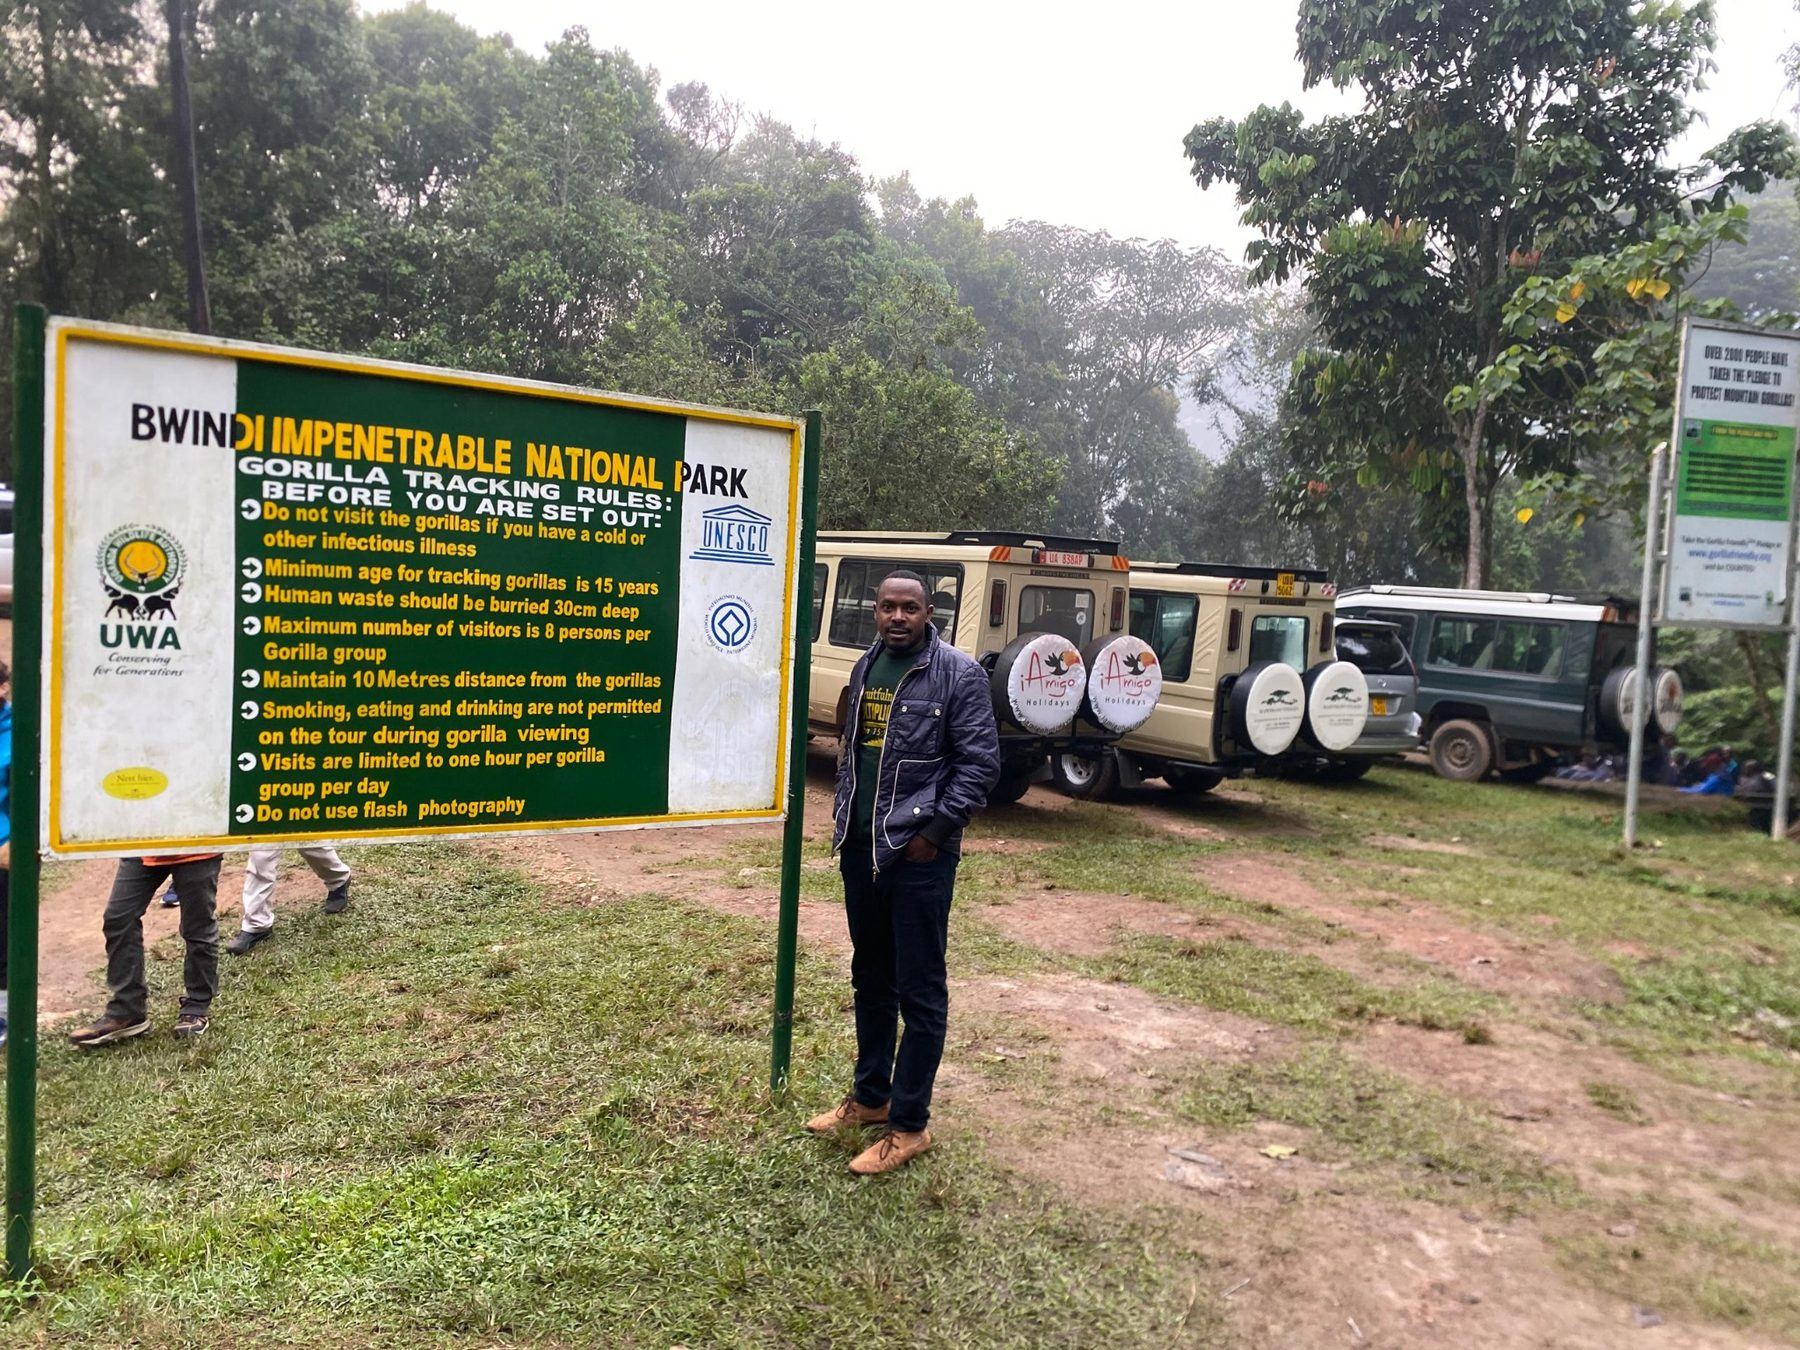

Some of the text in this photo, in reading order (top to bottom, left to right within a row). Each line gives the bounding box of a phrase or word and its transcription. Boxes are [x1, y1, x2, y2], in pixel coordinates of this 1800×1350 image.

[1705, 345, 1722, 360] OVER
[1745, 349, 1769, 364] PEOPLE
[1771, 351, 1788, 367] HAVE
[1709, 366, 1782, 386] TAKEN THE PLEDGE TO
[1691, 385, 1722, 401] PROTECT
[1724, 388, 1759, 404] MOUNTAIN
[131, 403, 749, 499] BWINDI IMPENETRABLE NATIONAL PARK
[238, 456, 672, 511] GORILLA TRACKING RULES:
[262, 481, 662, 528] BEFORE YOU ARE SET OUT:
[263, 501, 646, 546] Do not visit the gorillas if you have a cold or
[263, 530, 477, 557] other infectious illness
[703, 520, 768, 552] UNESCO
[265, 558, 659, 598] Minimum age for tracking gorillas is 15 years
[265, 584, 639, 622] Human waste should be burried 30cm deep
[100, 624, 182, 650] UWA
[264, 616, 651, 644] Maximum number of visitors is 8 persons per
[108, 652, 171, 665] Conserving
[263, 642, 387, 665] Gorilla group
[93, 665, 184, 678] for Generations
[263, 670, 346, 688] Maintain
[454, 671, 526, 687] distance
[530, 671, 566, 687] from
[576, 672, 601, 687] the
[605, 673, 662, 691] gorillas
[263, 699, 662, 722] Smoking, eating and drinking are not permitted
[1026, 698, 1070, 707] Holidays
[1105, 696, 1146, 705] Holidays
[258, 724, 589, 748] on the tour during gorilla viewing
[260, 747, 605, 771] Visits are limited to one hour per gorilla
[259, 777, 390, 801] group per day
[257, 796, 525, 822] Do not use flash photography
